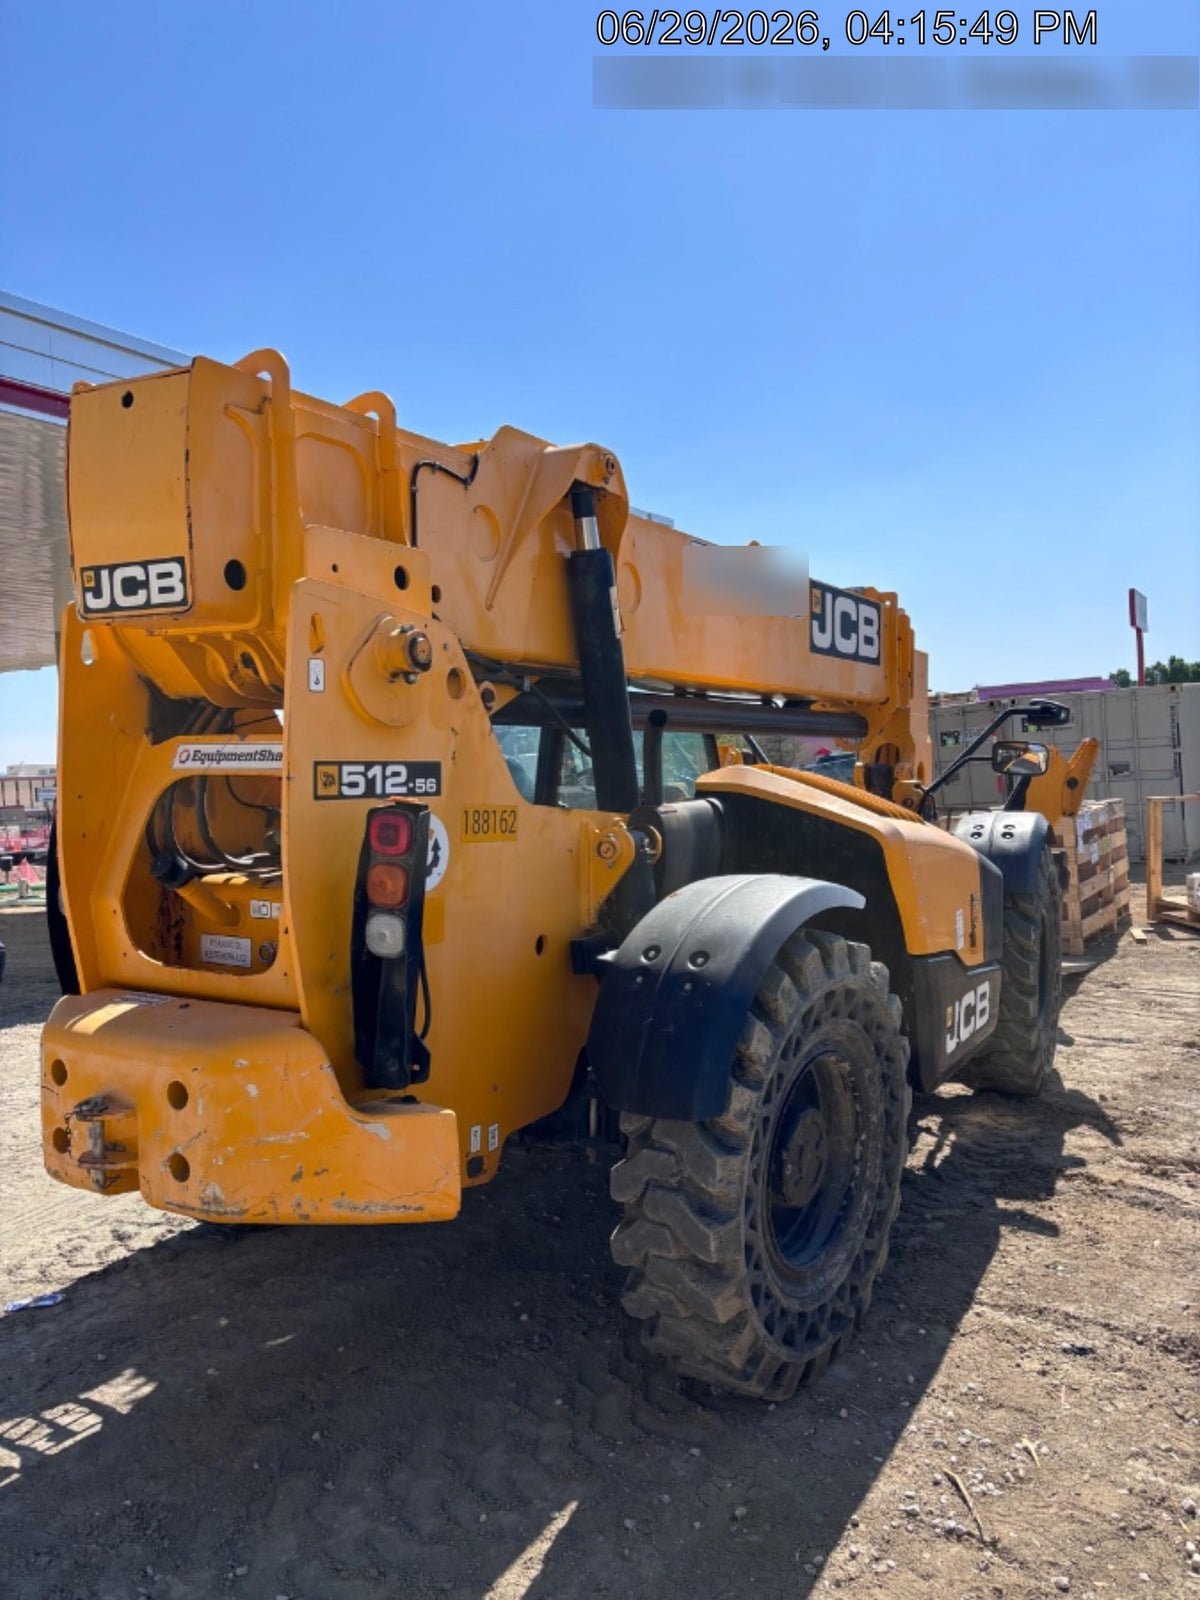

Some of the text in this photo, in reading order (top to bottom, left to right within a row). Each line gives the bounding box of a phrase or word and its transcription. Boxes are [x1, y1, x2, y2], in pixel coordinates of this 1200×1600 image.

[84, 562, 184, 609] JCB
[812, 591, 879, 659] JCB
[463, 810, 517, 835] 188162
[945, 981, 990, 1053] JCB
